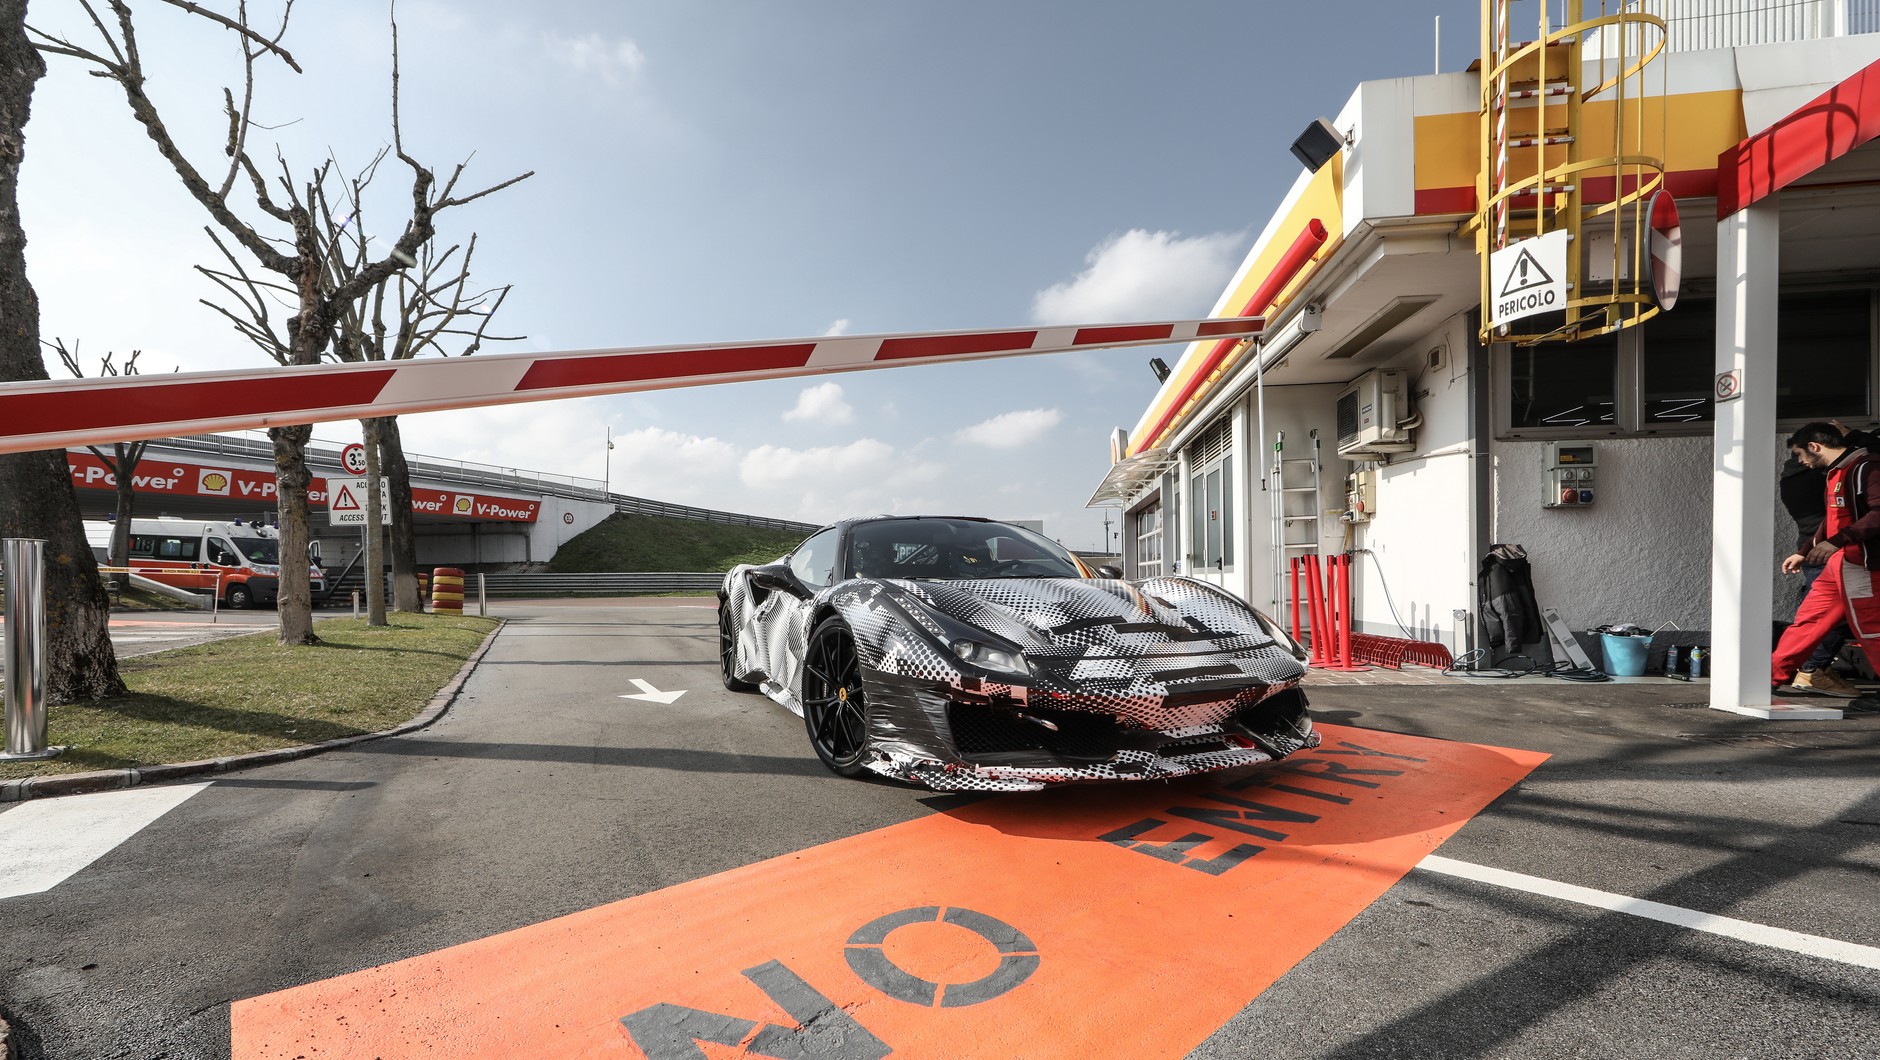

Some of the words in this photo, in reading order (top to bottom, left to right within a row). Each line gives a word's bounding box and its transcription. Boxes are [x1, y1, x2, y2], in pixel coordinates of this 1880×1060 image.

[1499, 290, 1555, 318] PERICOLO
[339, 514, 365, 522] ACCESS
[619, 905, 1041, 1060] NO
[1097, 741, 1428, 876] ENTRY
